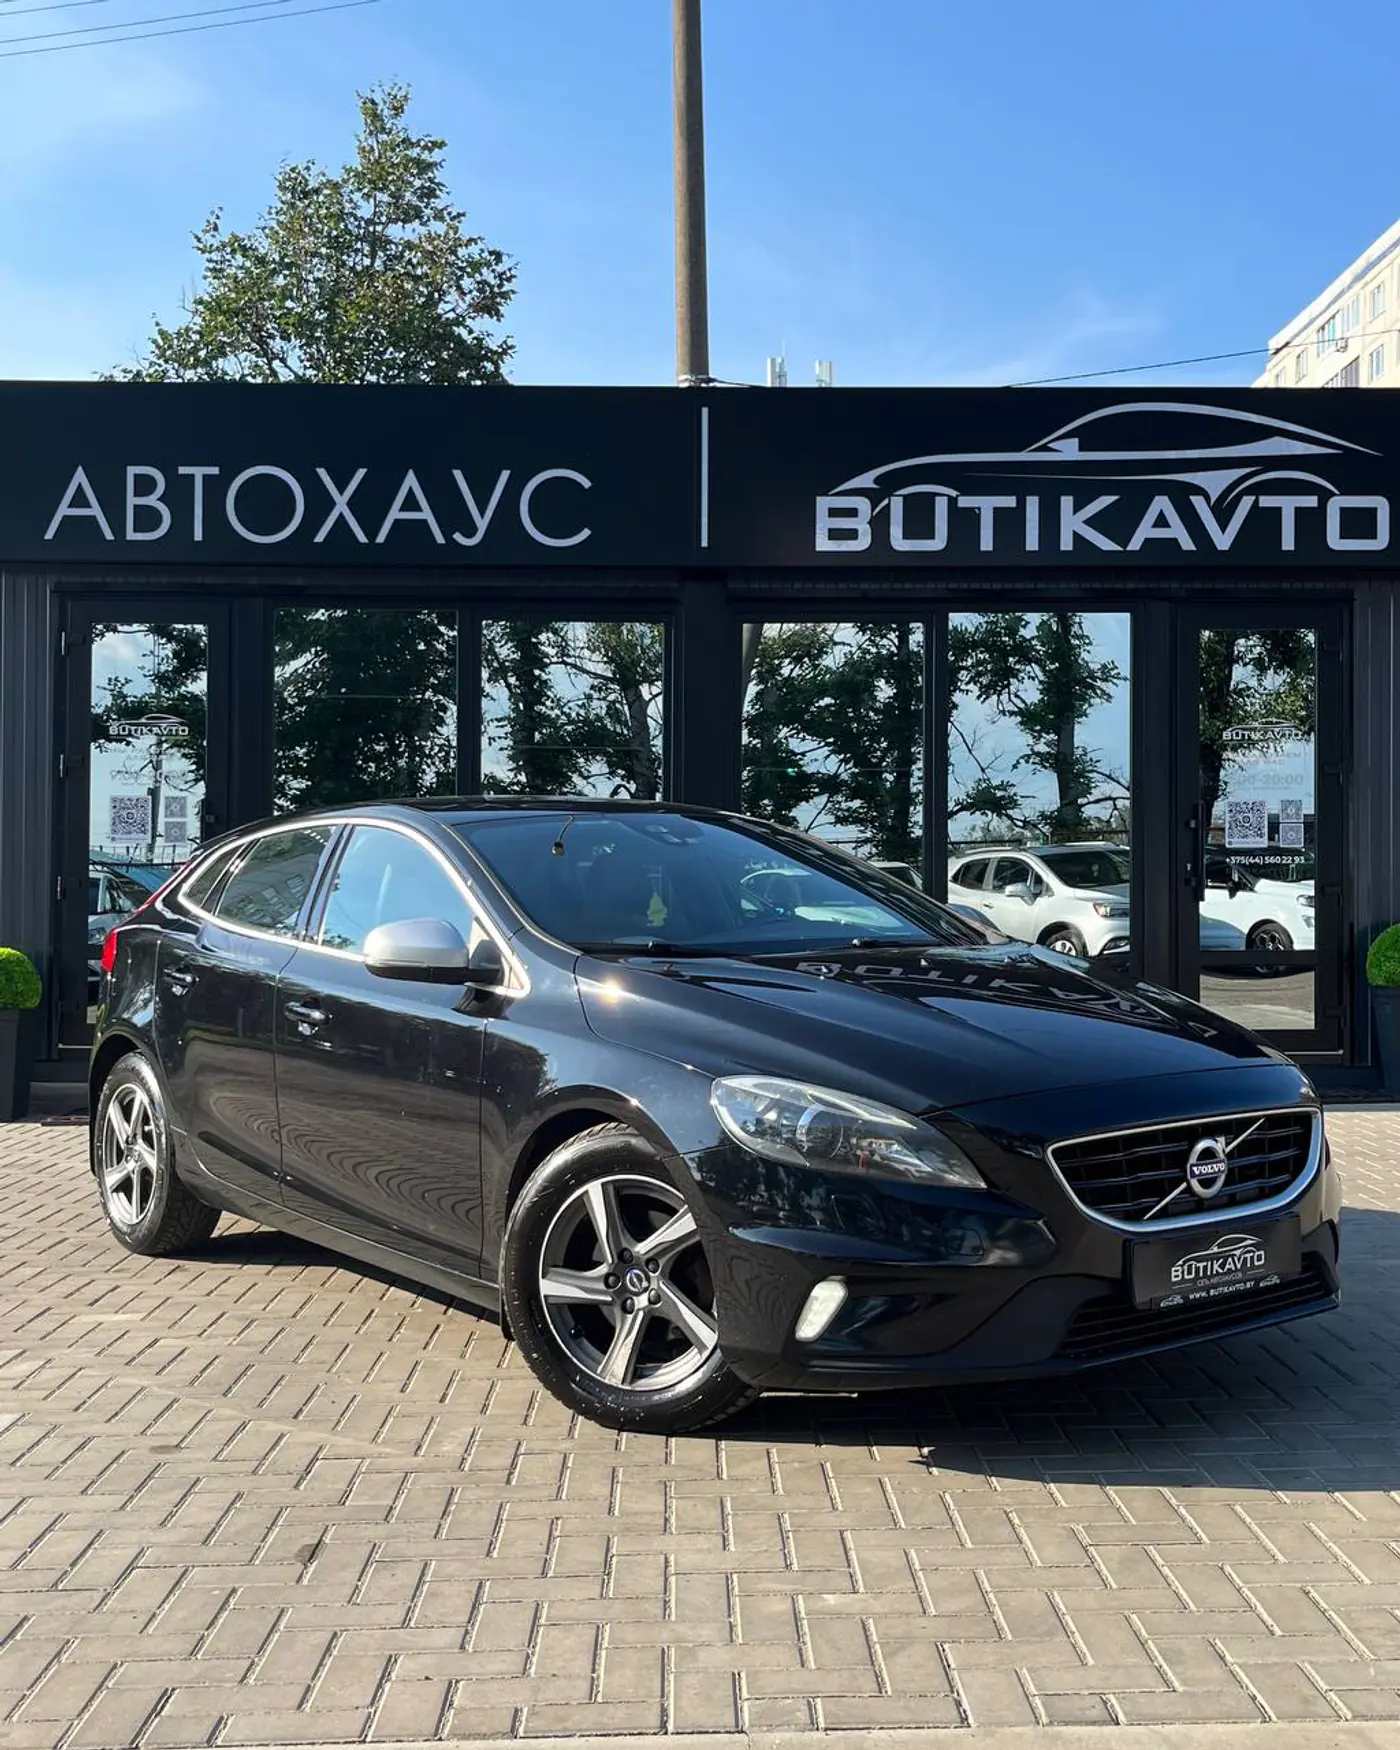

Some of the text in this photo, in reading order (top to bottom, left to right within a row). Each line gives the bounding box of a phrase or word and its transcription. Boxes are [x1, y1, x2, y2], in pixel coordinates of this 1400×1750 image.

[43, 464, 593, 548] АВТОХАУС
[815, 494, 1390, 552] BUTIKAVTO
[1265, 855, 1281, 864] 560
[1282, 855, 1293, 864] 22
[1293, 855, 1305, 864] 93
[1192, 1163, 1225, 1175] VOLVO
[1171, 1250, 1265, 1282] BUTIKAVTO
